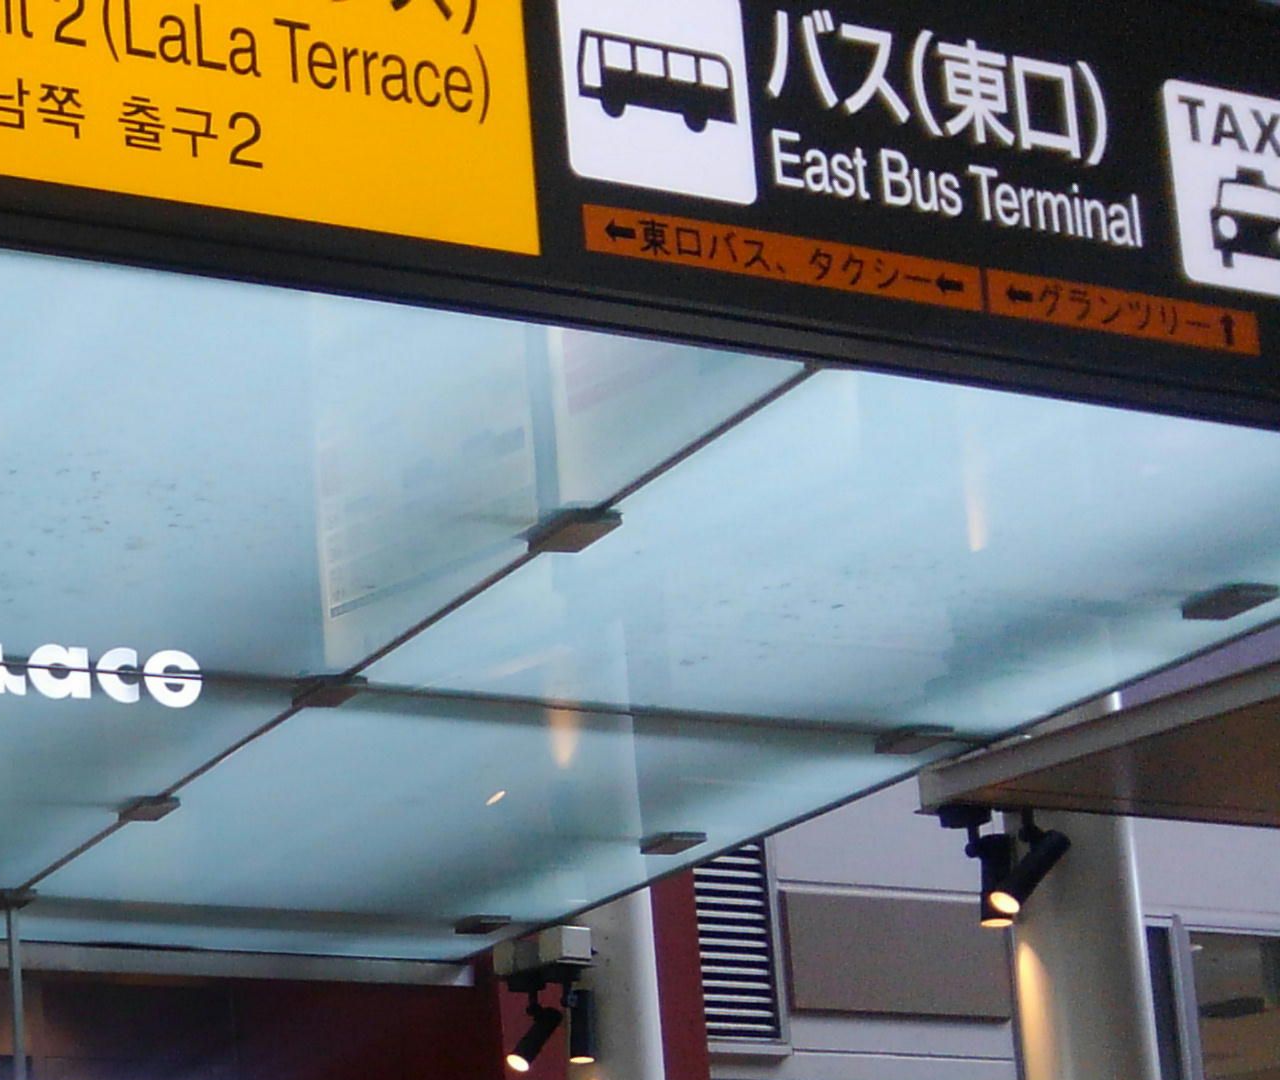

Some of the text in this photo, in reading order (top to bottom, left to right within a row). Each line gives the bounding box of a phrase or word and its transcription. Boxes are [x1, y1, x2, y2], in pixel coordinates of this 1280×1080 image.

[54, 0, 87, 47] 2
[102, 0, 261, 78] (LaLa
[273, 17, 490, 125] Terrace)
[767, 9, 1108, 166] バス(東口)
[118, 95, 264, 169] 출구2
[771, 128, 1144, 248] East Bus Terminal
[638, 219, 932, 289] 東口バス、タクシー
[1040, 284, 1210, 336] グランツリー
